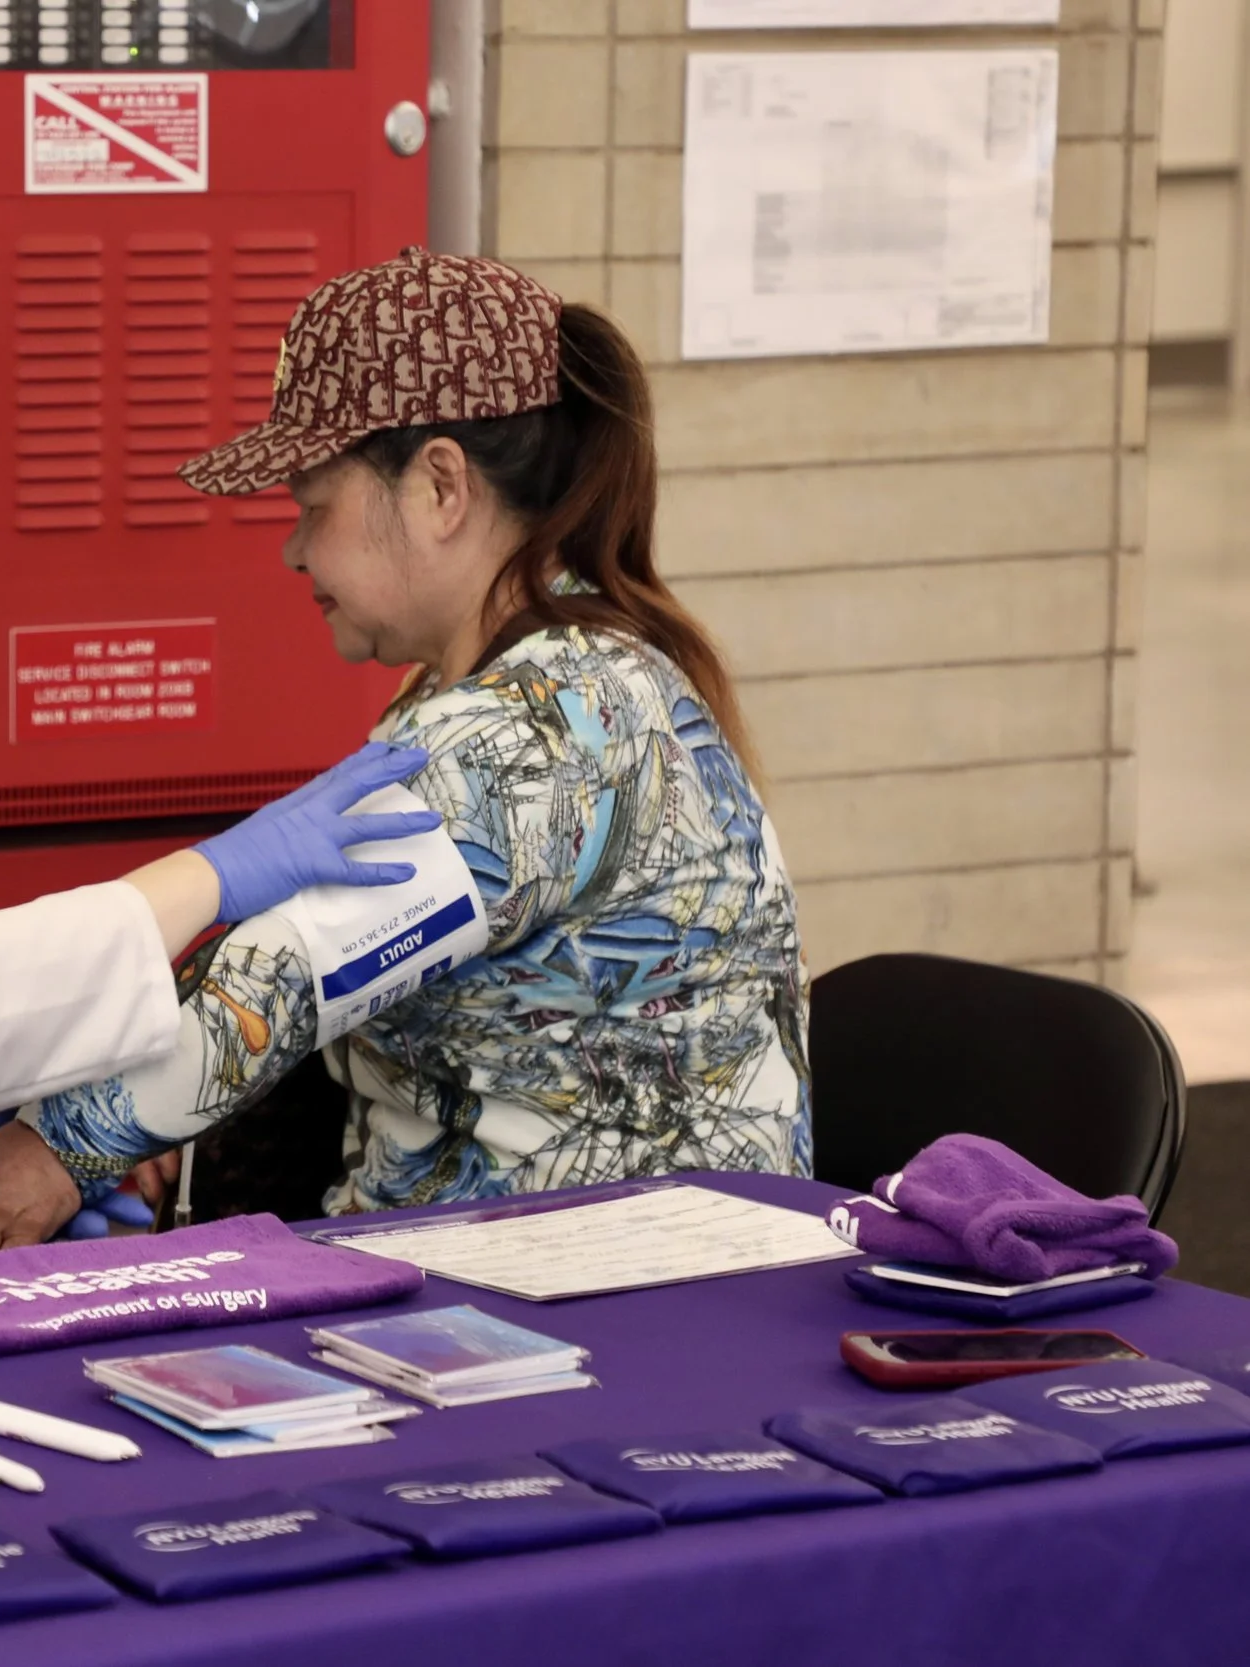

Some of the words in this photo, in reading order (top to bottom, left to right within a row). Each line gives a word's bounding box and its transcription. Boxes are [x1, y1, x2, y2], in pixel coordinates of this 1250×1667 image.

[35, 116, 79, 129] CALL
[74, 641, 103, 658] FIRE
[107, 639, 155, 657] ALARM
[17, 665, 72, 683] SERVICE
[76, 661, 155, 681] DISCONNECT
[159, 658, 211, 677] SWITCH
[34, 685, 92, 705] LOCATED
[96, 684, 111, 700] IN
[115, 682, 154, 699] ROOM
[31, 709, 66, 726] MAIN
[70, 705, 154, 724] SWITCHGEAR
[157, 702, 196, 719] ROOM
[403, 896, 437, 922] RANGE
[342, 943, 358, 954] cm
[380, 929, 423, 968] ADULT
[1, 1268, 212, 1300] Health
[181, 1287, 268, 1312] Surgery
[1057, 1390, 1117, 1407] NYU
[1110, 1380, 1211, 1399] Langone
